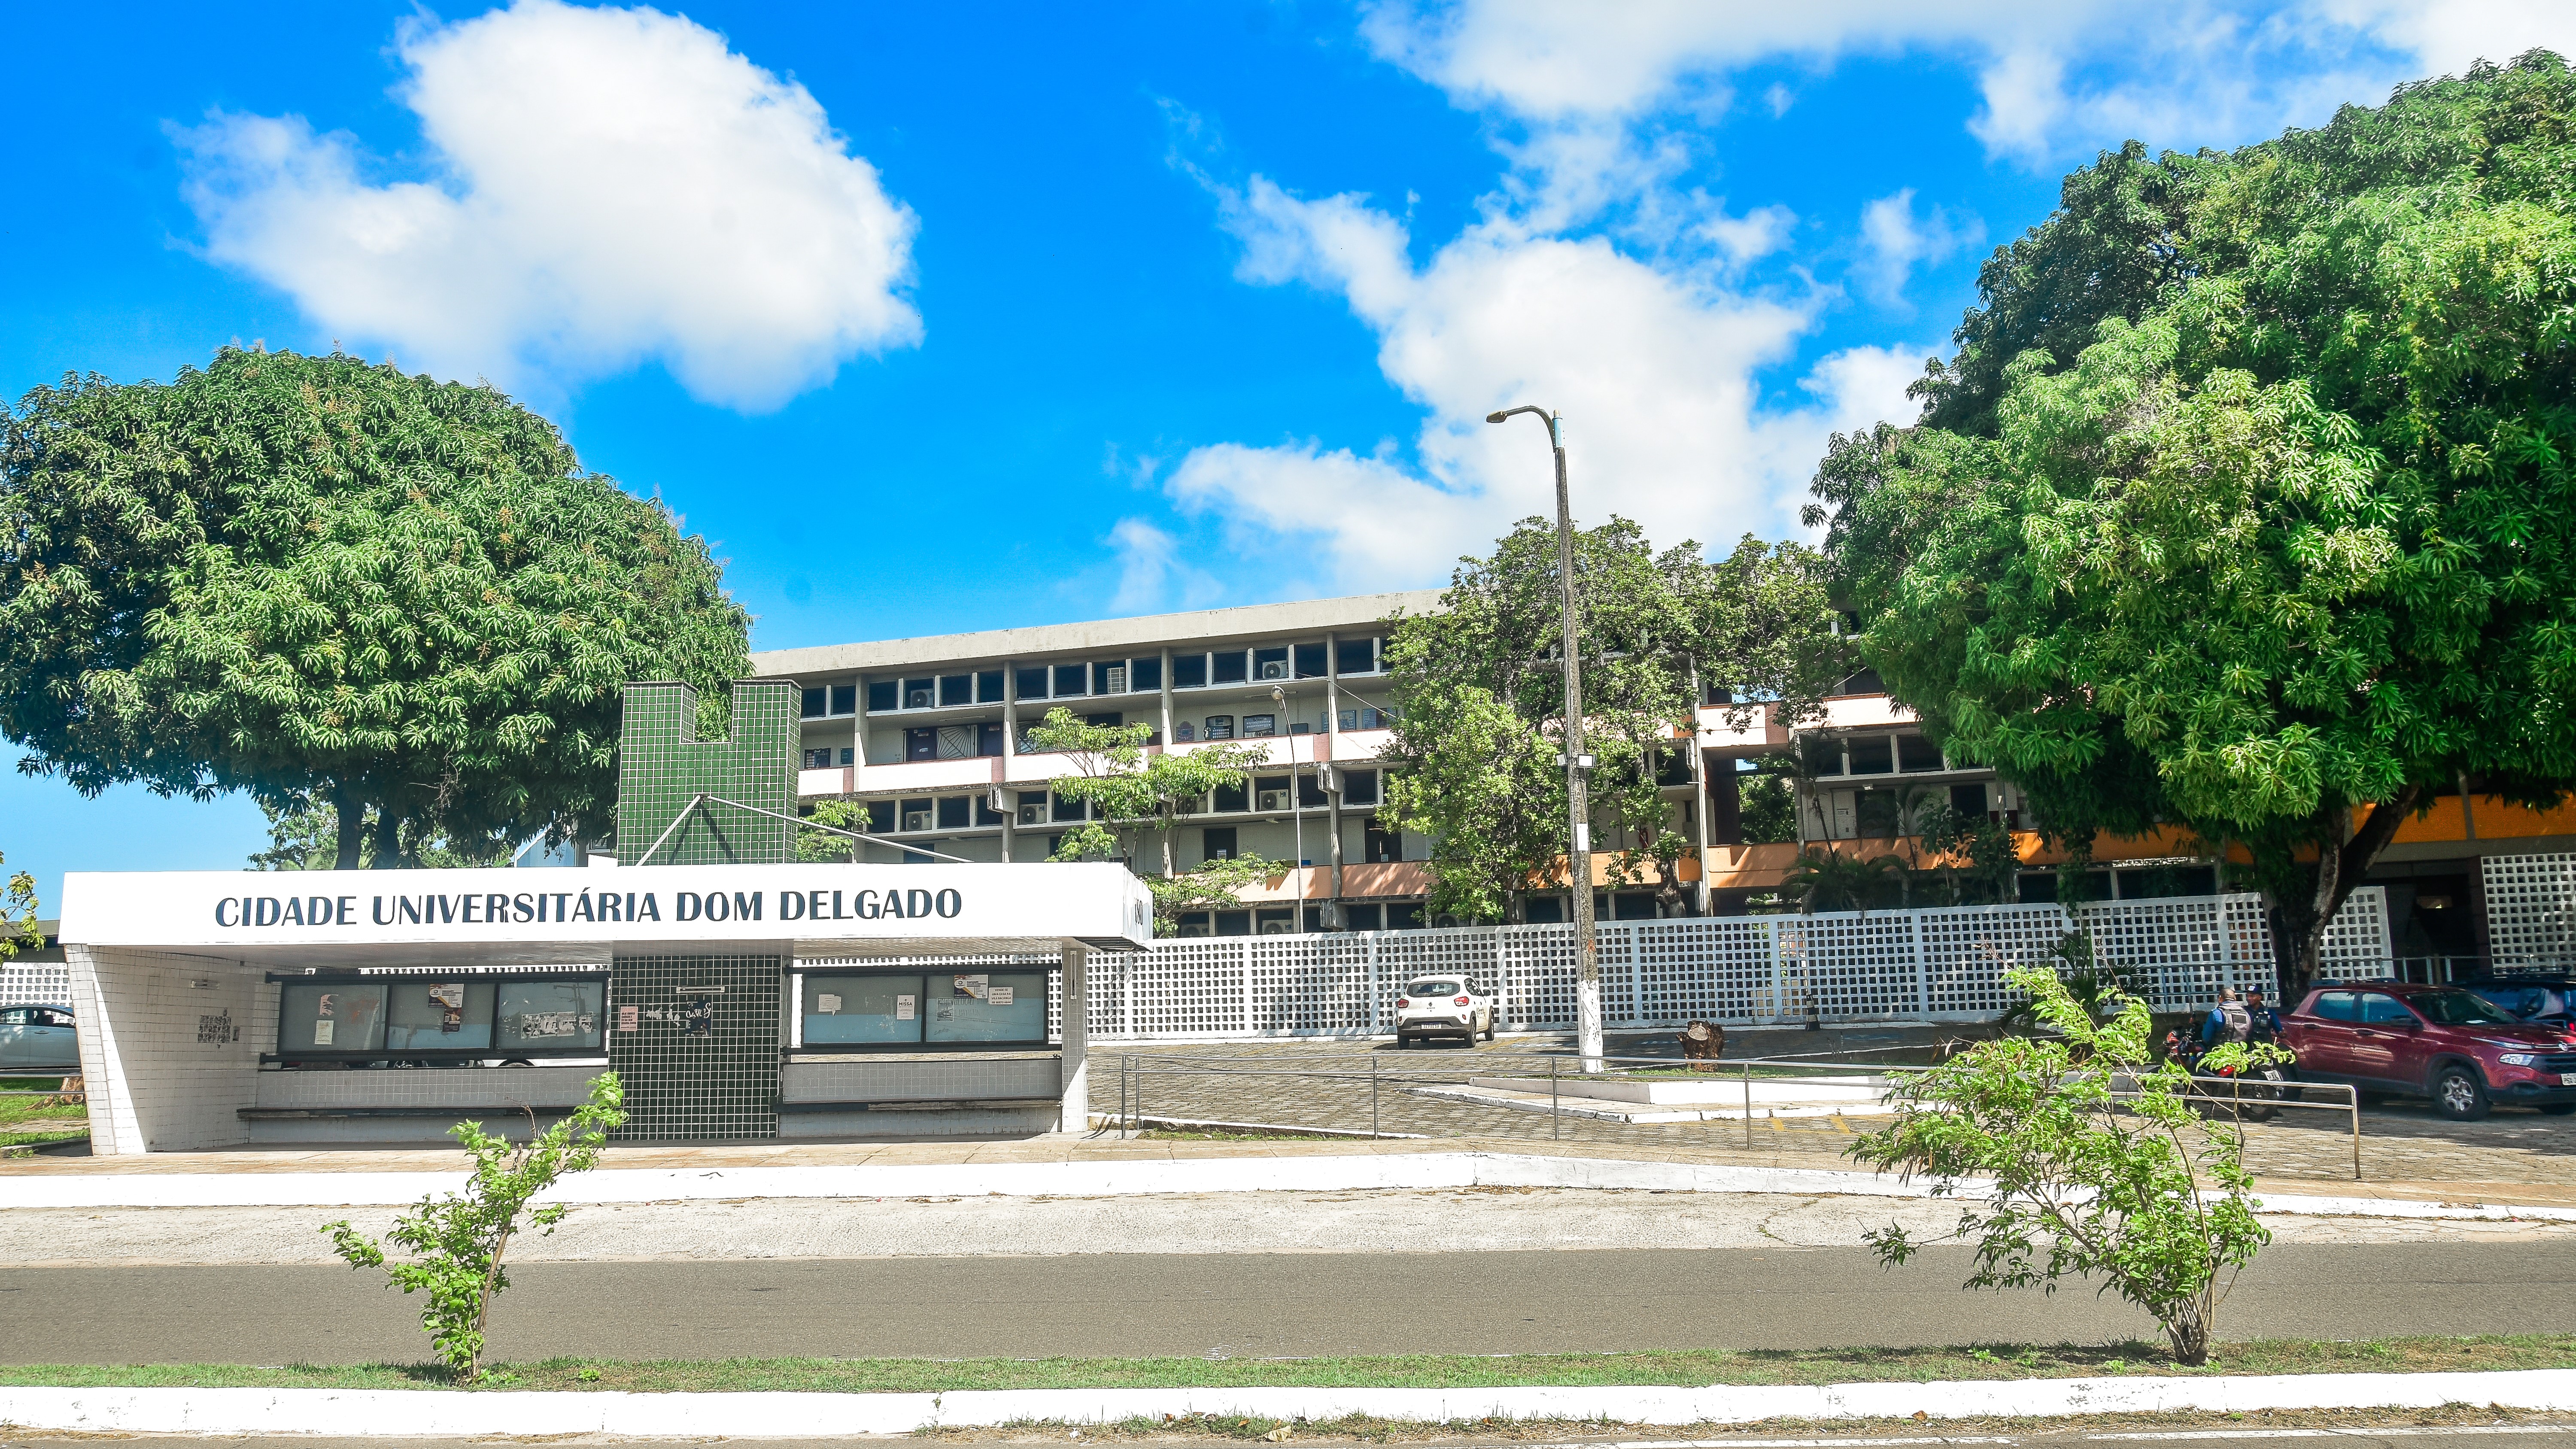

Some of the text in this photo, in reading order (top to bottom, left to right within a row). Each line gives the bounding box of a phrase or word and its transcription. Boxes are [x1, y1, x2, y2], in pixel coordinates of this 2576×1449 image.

[216, 887, 962, 927] CIDADE UNIVERSITÁRIA DOM DELGADO
